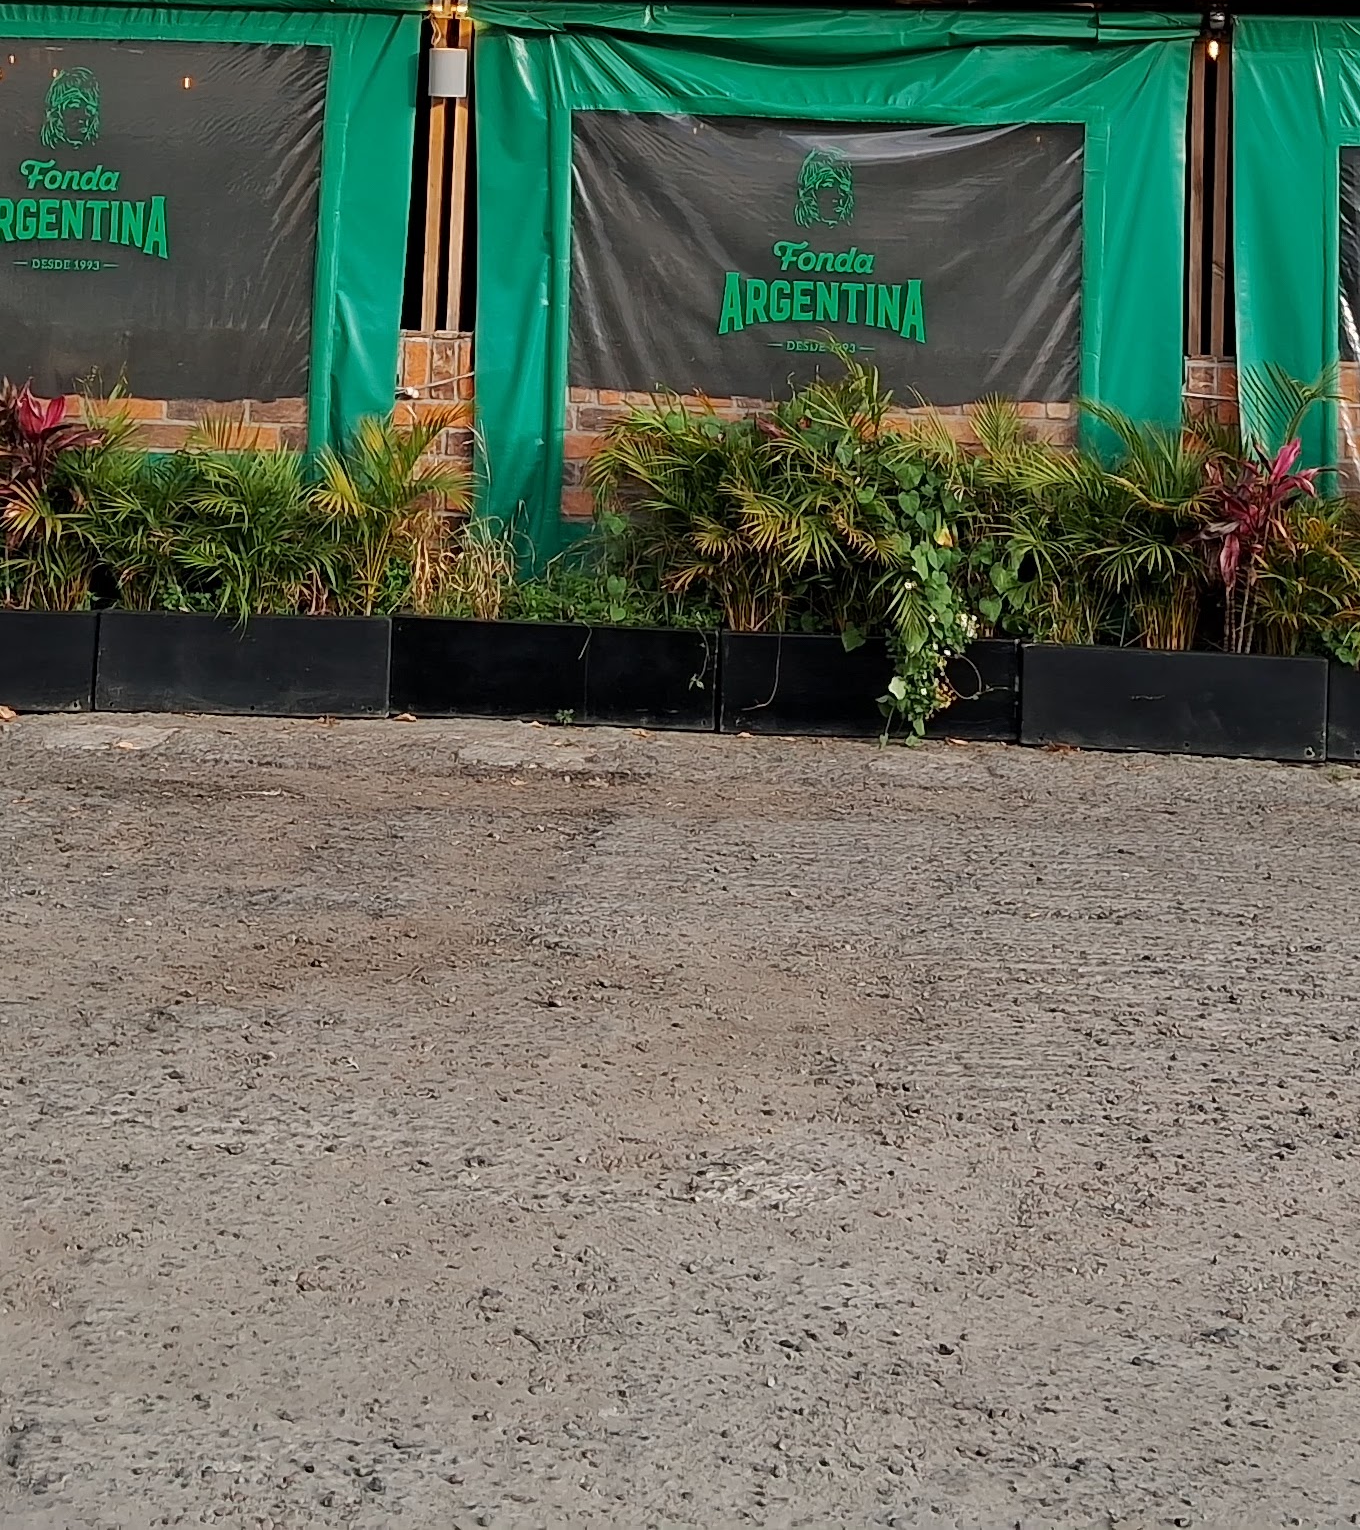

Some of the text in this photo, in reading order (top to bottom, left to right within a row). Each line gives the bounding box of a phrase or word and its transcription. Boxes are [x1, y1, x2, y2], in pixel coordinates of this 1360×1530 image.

[20, 159, 120, 191] Fonda
[32, 259, 99, 270] DESDE 1993
[774, 241, 875, 273] Fonda
[718, 272, 926, 344] ARGENTINA
[786, 341, 825, 351] DESDE
